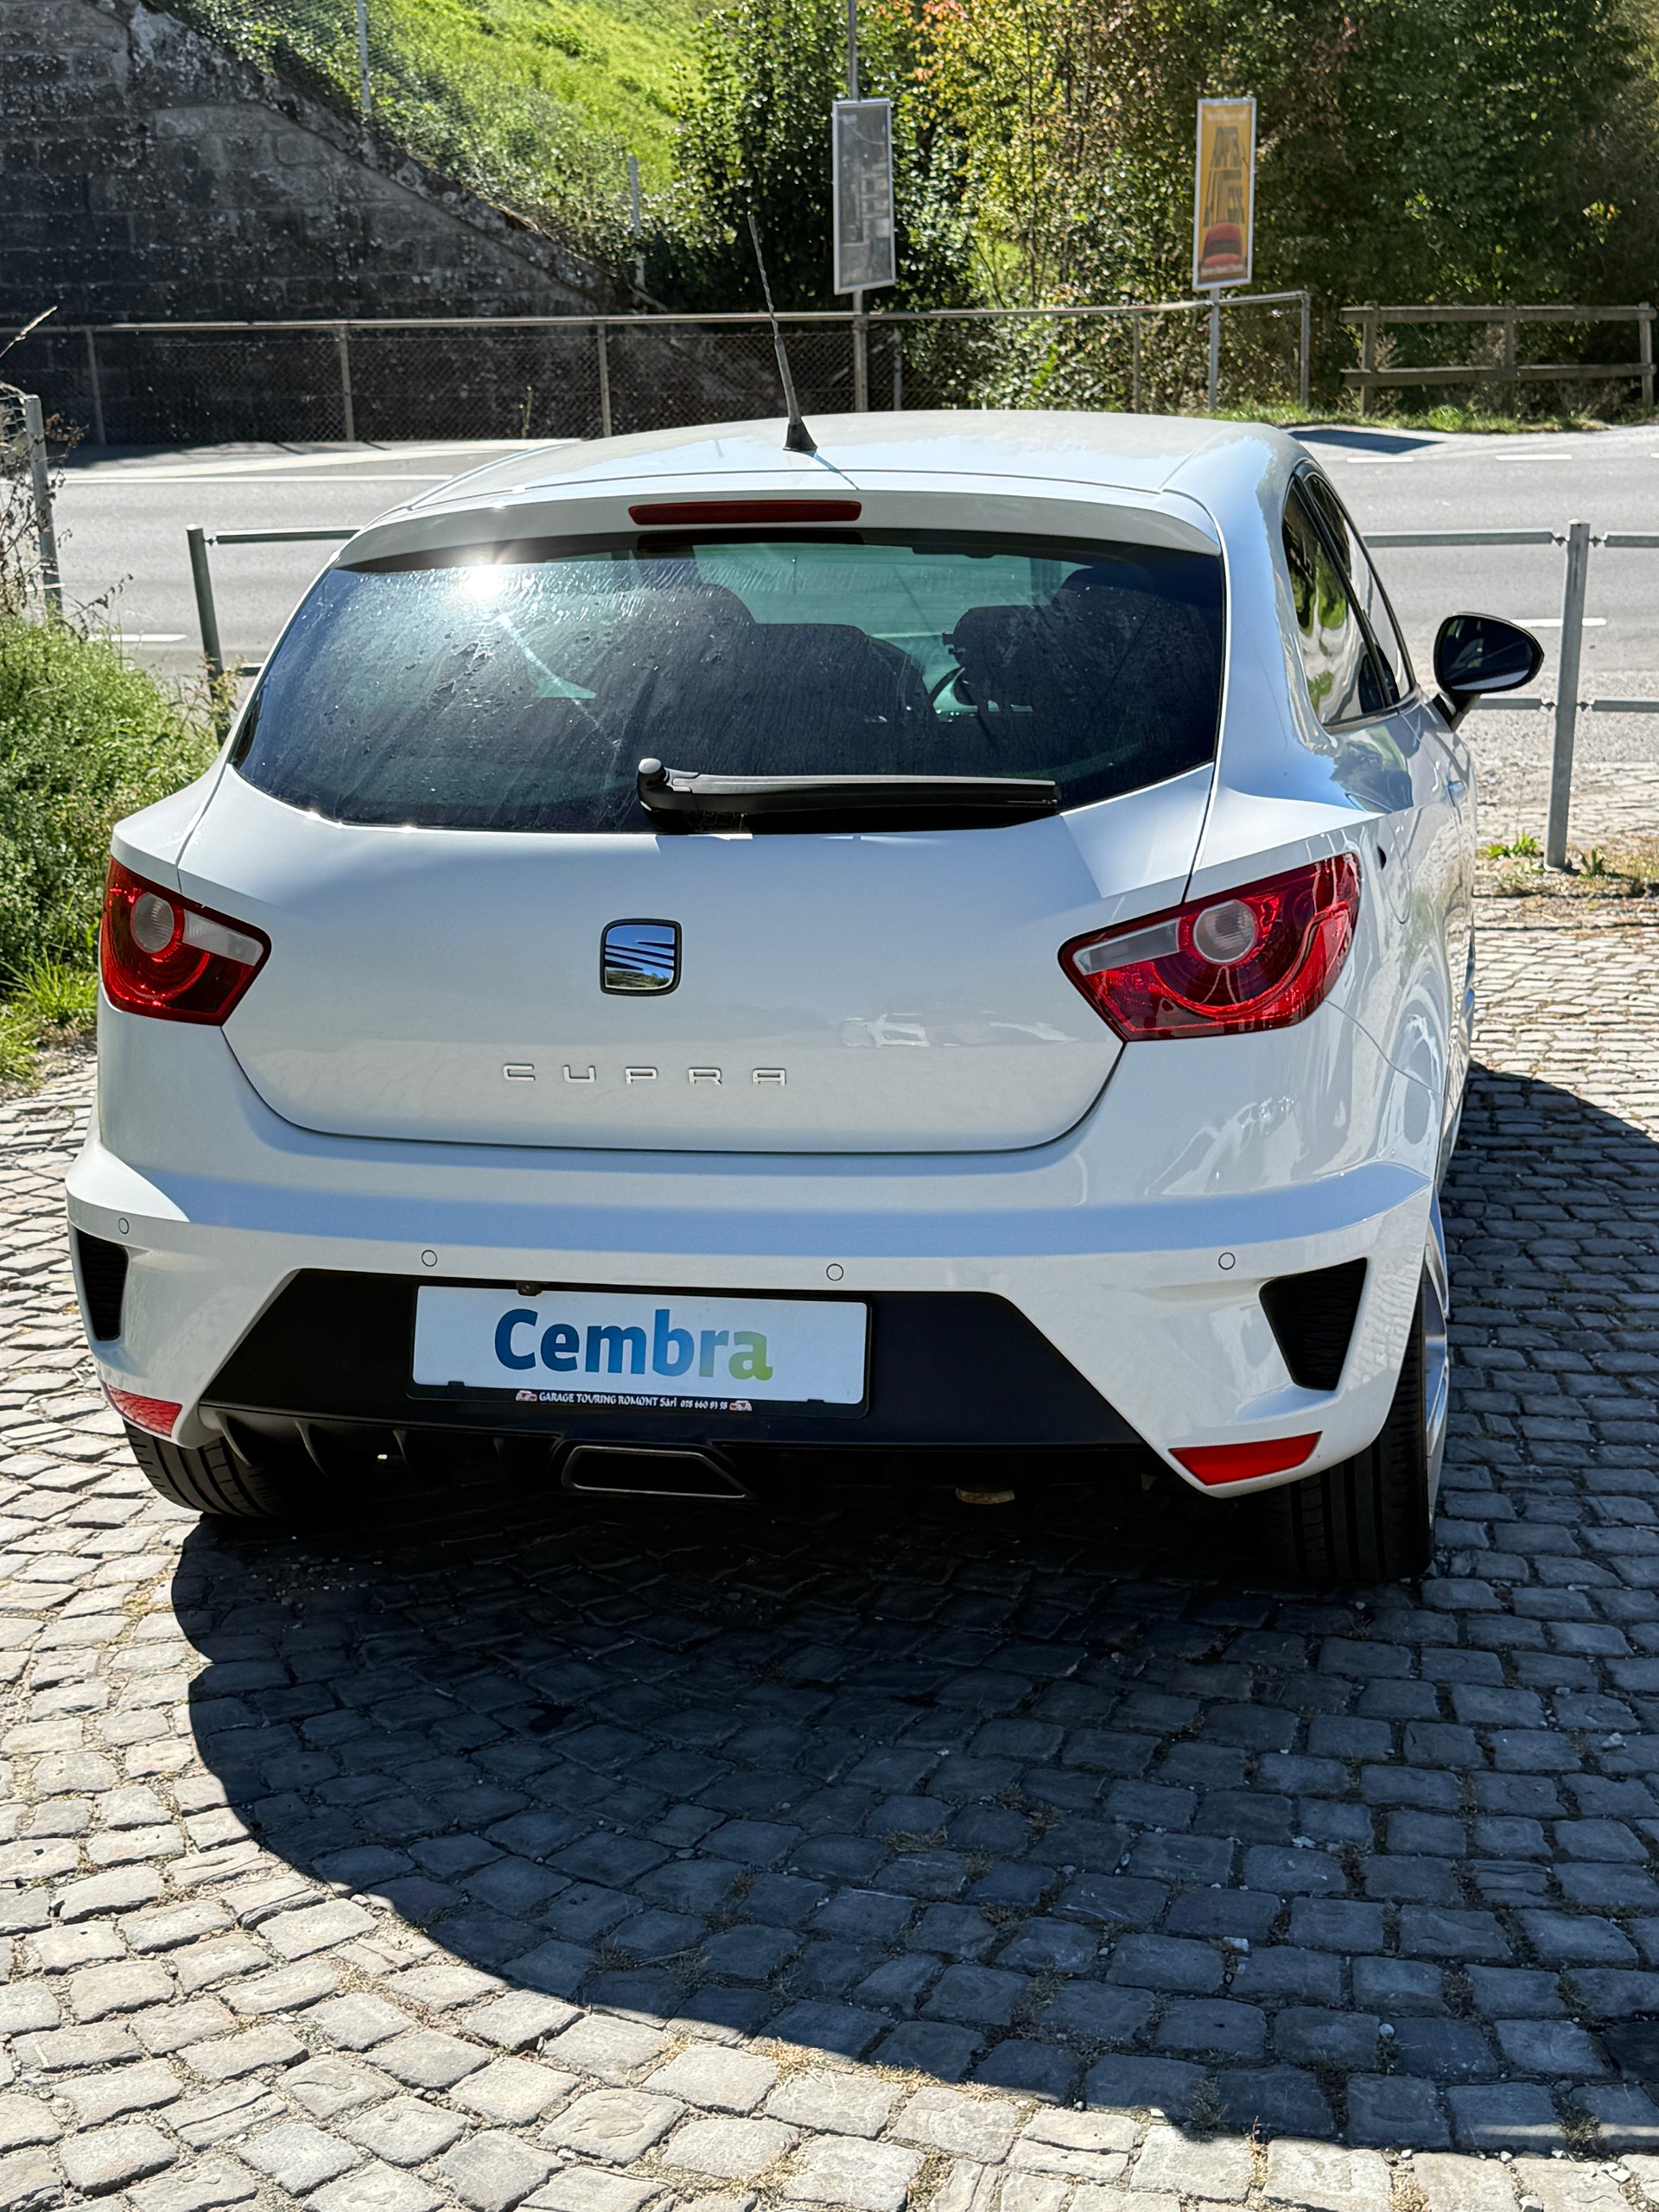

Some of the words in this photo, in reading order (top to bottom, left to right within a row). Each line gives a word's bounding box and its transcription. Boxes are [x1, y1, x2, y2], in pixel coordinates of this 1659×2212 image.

[503, 1063, 786, 1086] CUPRA
[494, 1308, 773, 1381] Cembra
[539, 1391, 575, 1402] GARAGE
[575, 1393, 617, 1405] TOURING
[618, 1395, 659, 1407] ROMONT
[694, 1400, 709, 1409] 660
